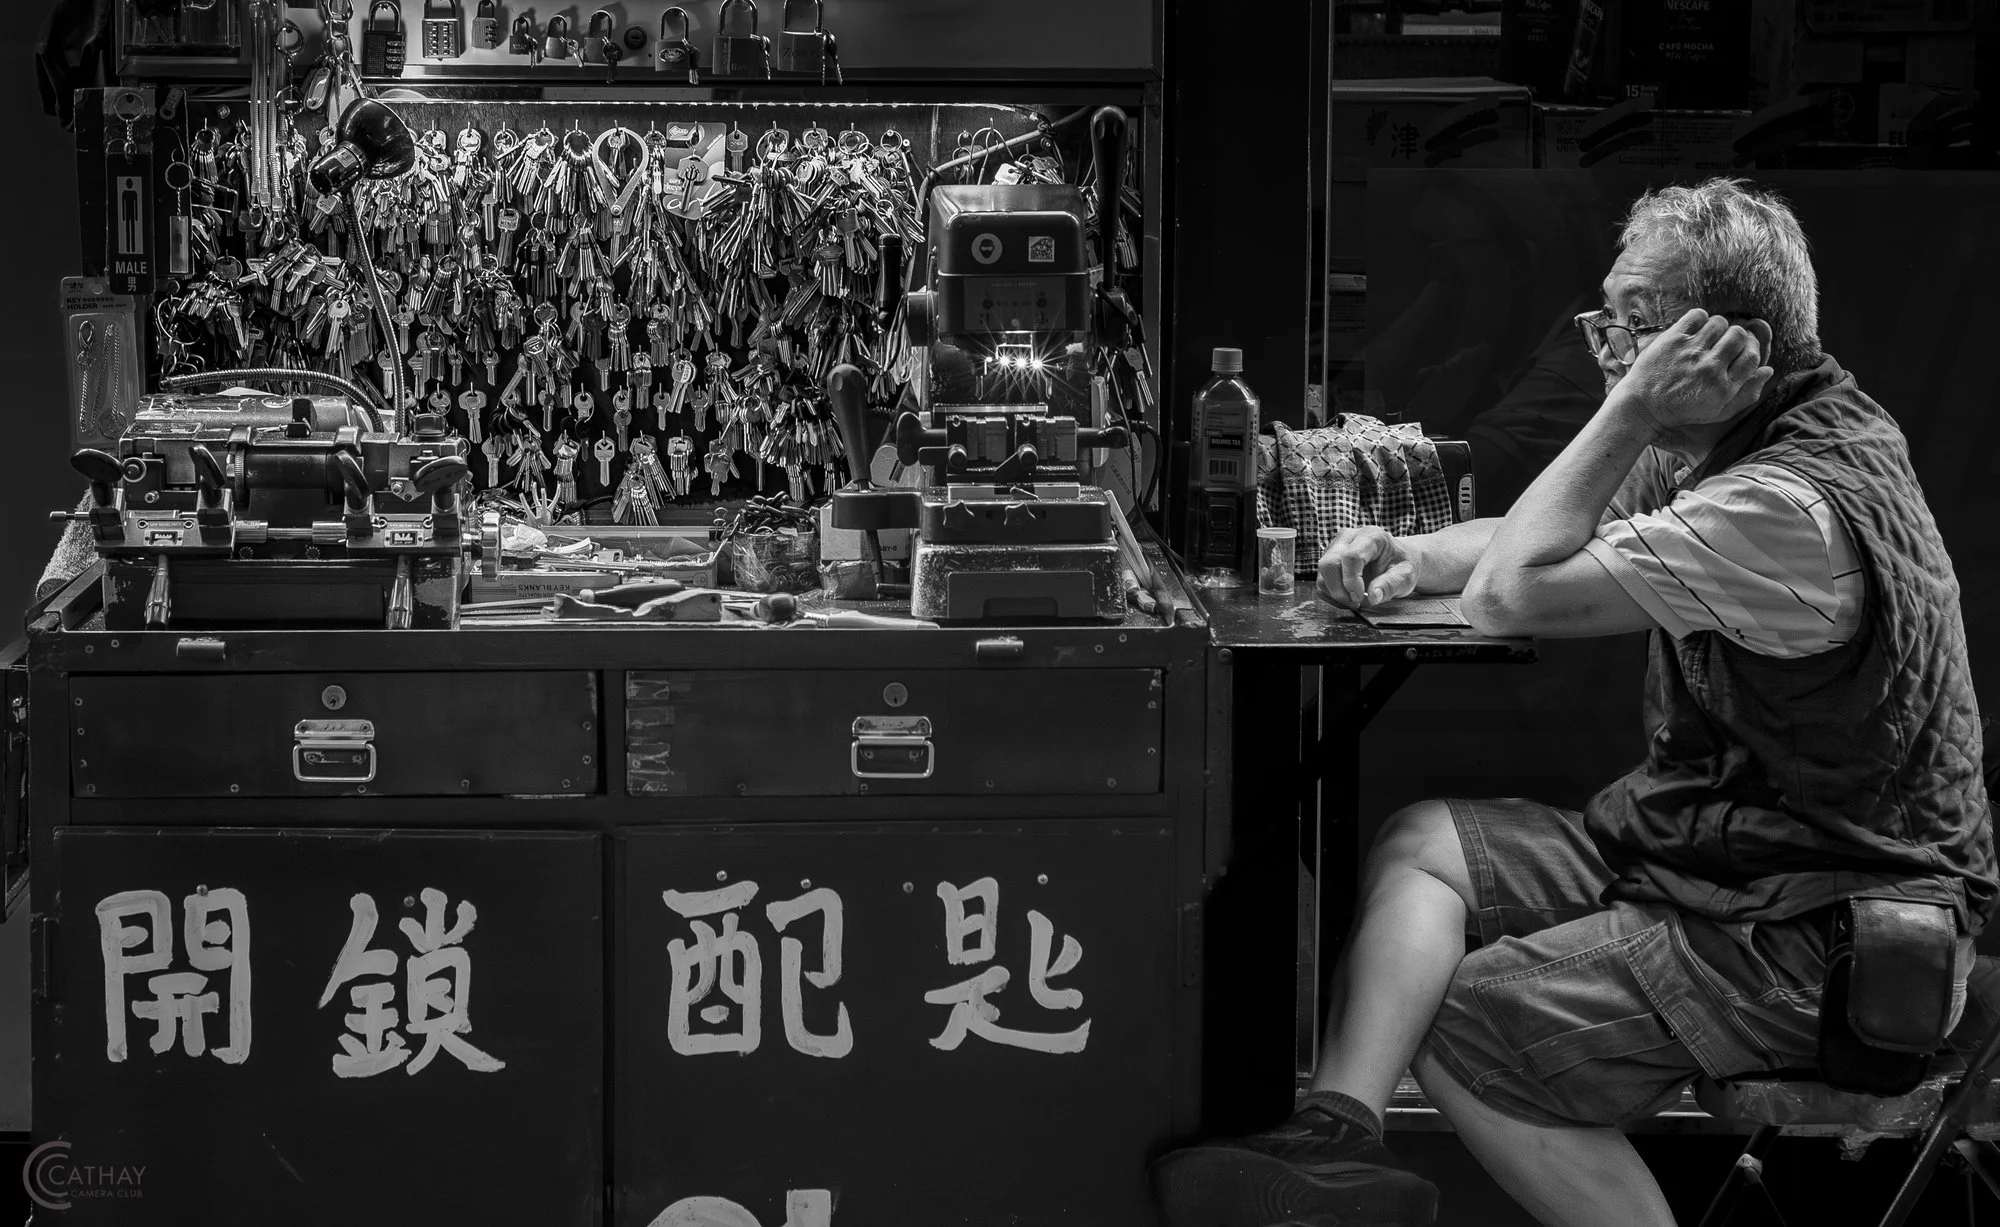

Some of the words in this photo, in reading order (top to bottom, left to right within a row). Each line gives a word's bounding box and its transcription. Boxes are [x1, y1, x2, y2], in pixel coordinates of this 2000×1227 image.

[1625, 84, 1639, 97] 15
[1391, 122, 1420, 160] 津
[115, 260, 148, 275] MALE
[127, 276, 137, 292] 男
[67, 302, 98, 310] HOLDER
[661, 876, 1092, 1059] 配匙
[95, 885, 507, 1079] 開鎖
